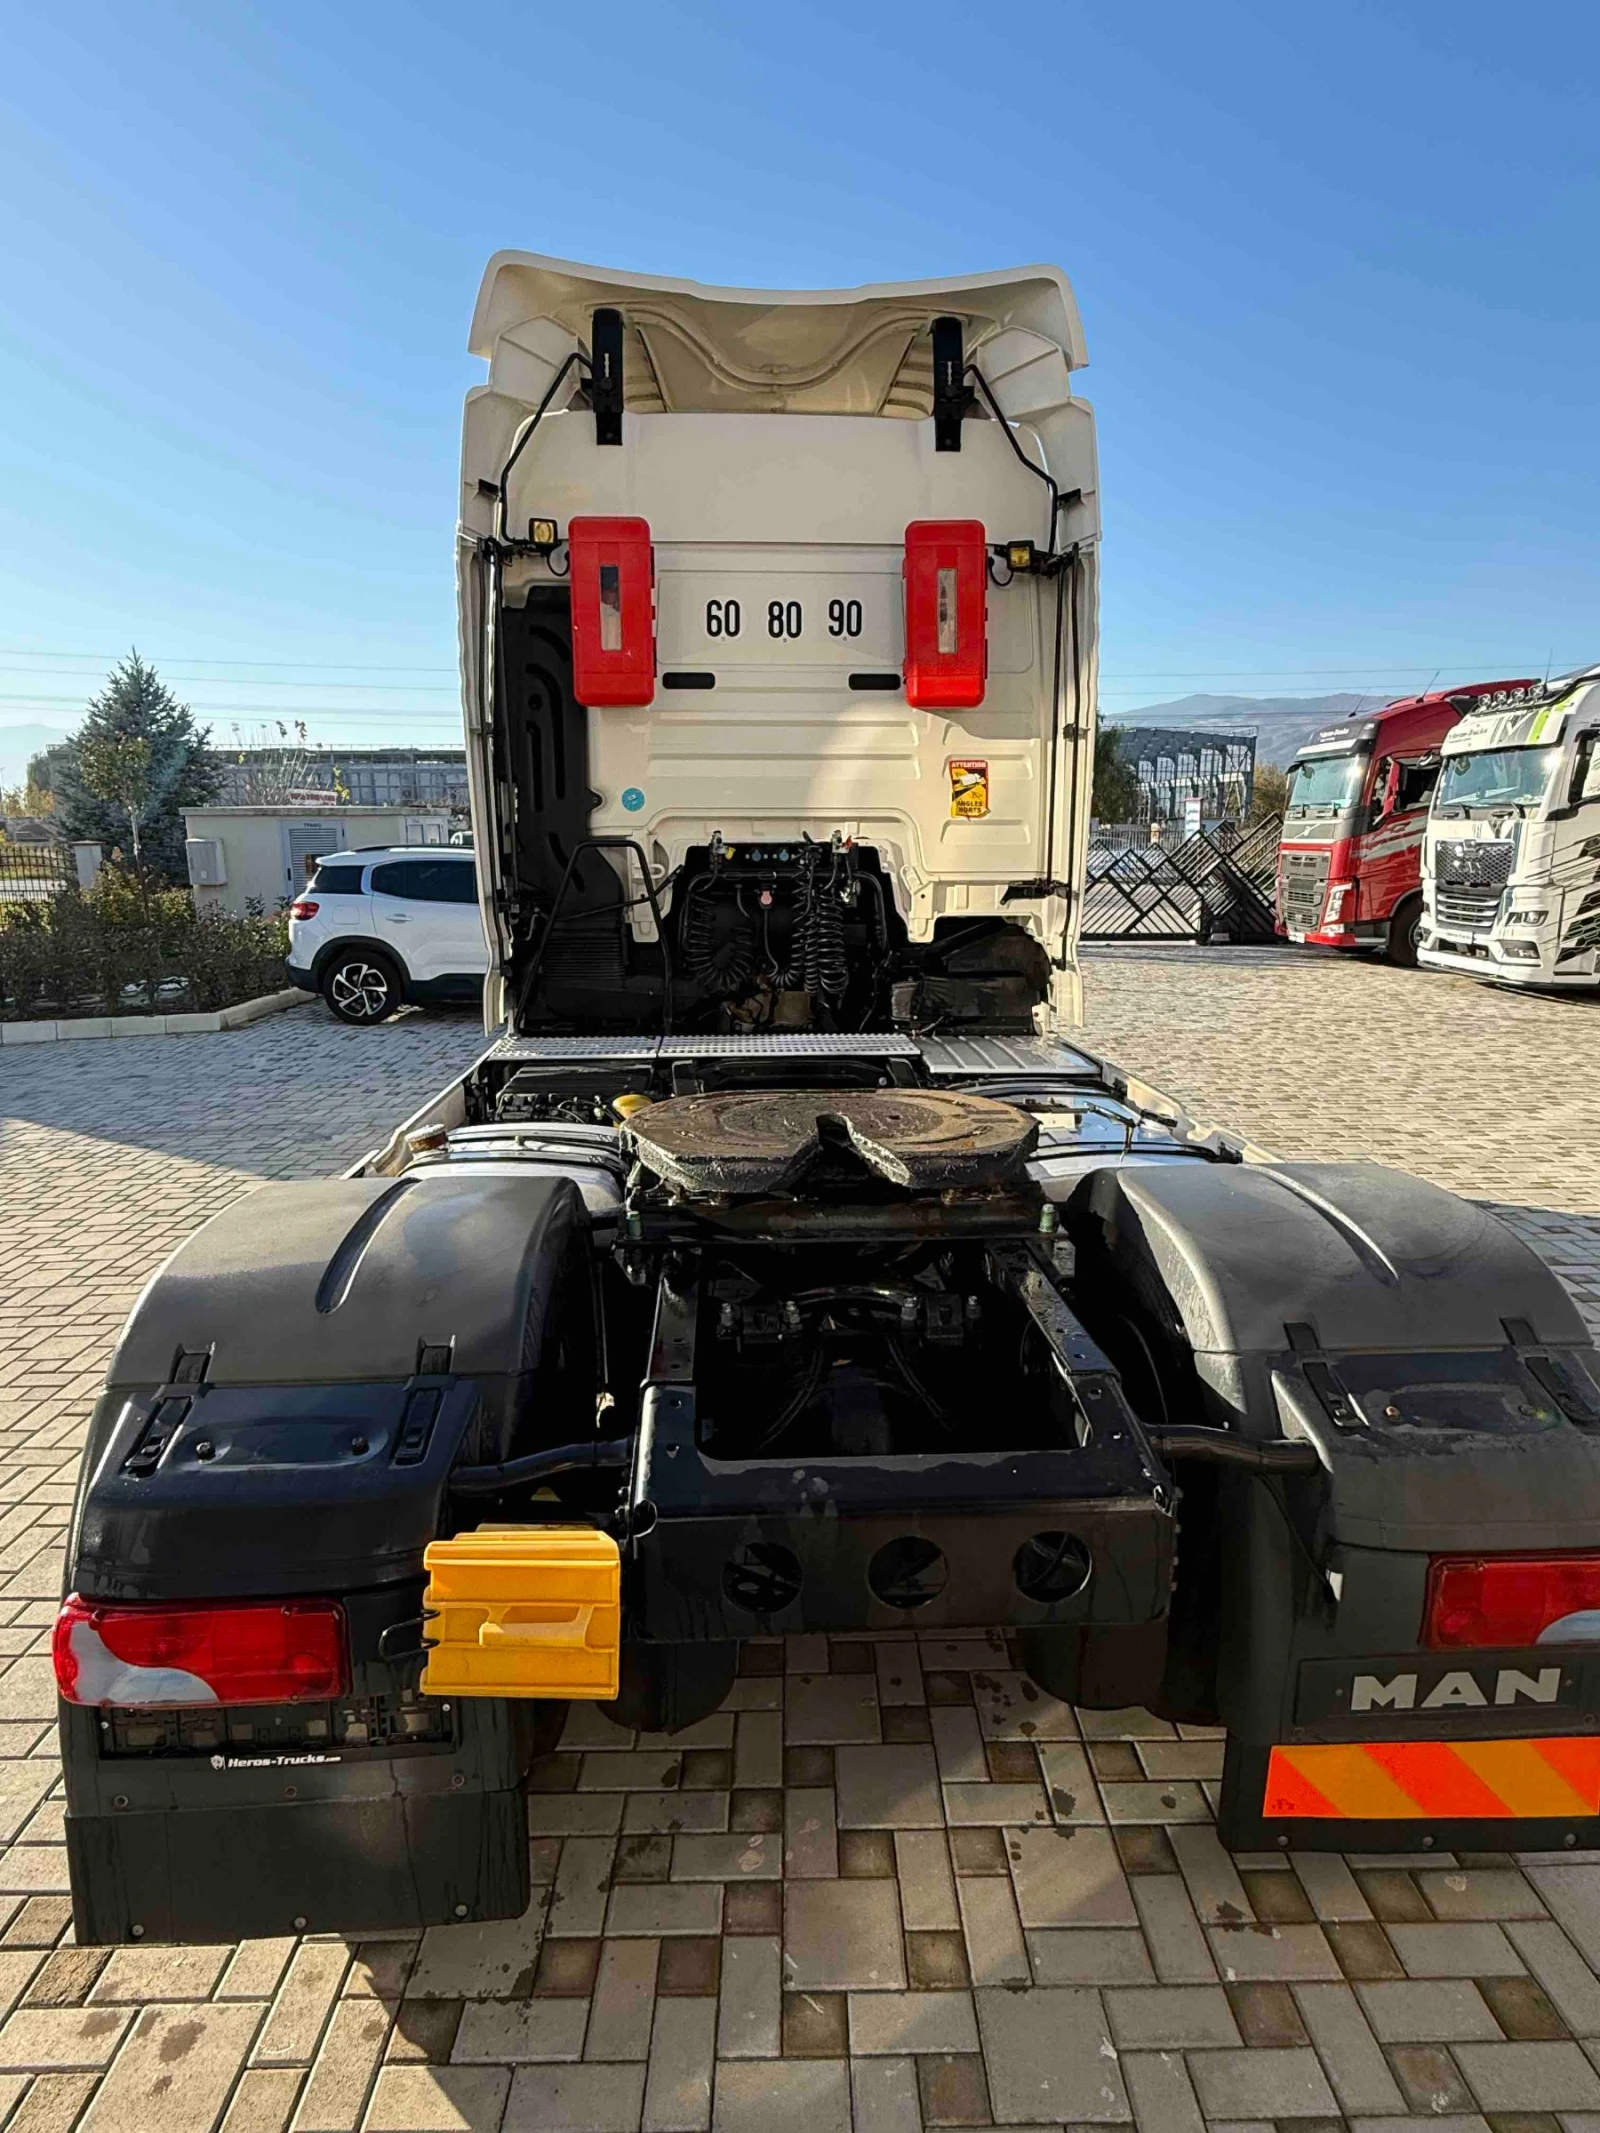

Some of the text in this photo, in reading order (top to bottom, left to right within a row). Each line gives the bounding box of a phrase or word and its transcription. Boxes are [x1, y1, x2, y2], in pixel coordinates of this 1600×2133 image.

[707, 599, 863, 639] 60 80 90
[1351, 1668, 1561, 1710] MAN
